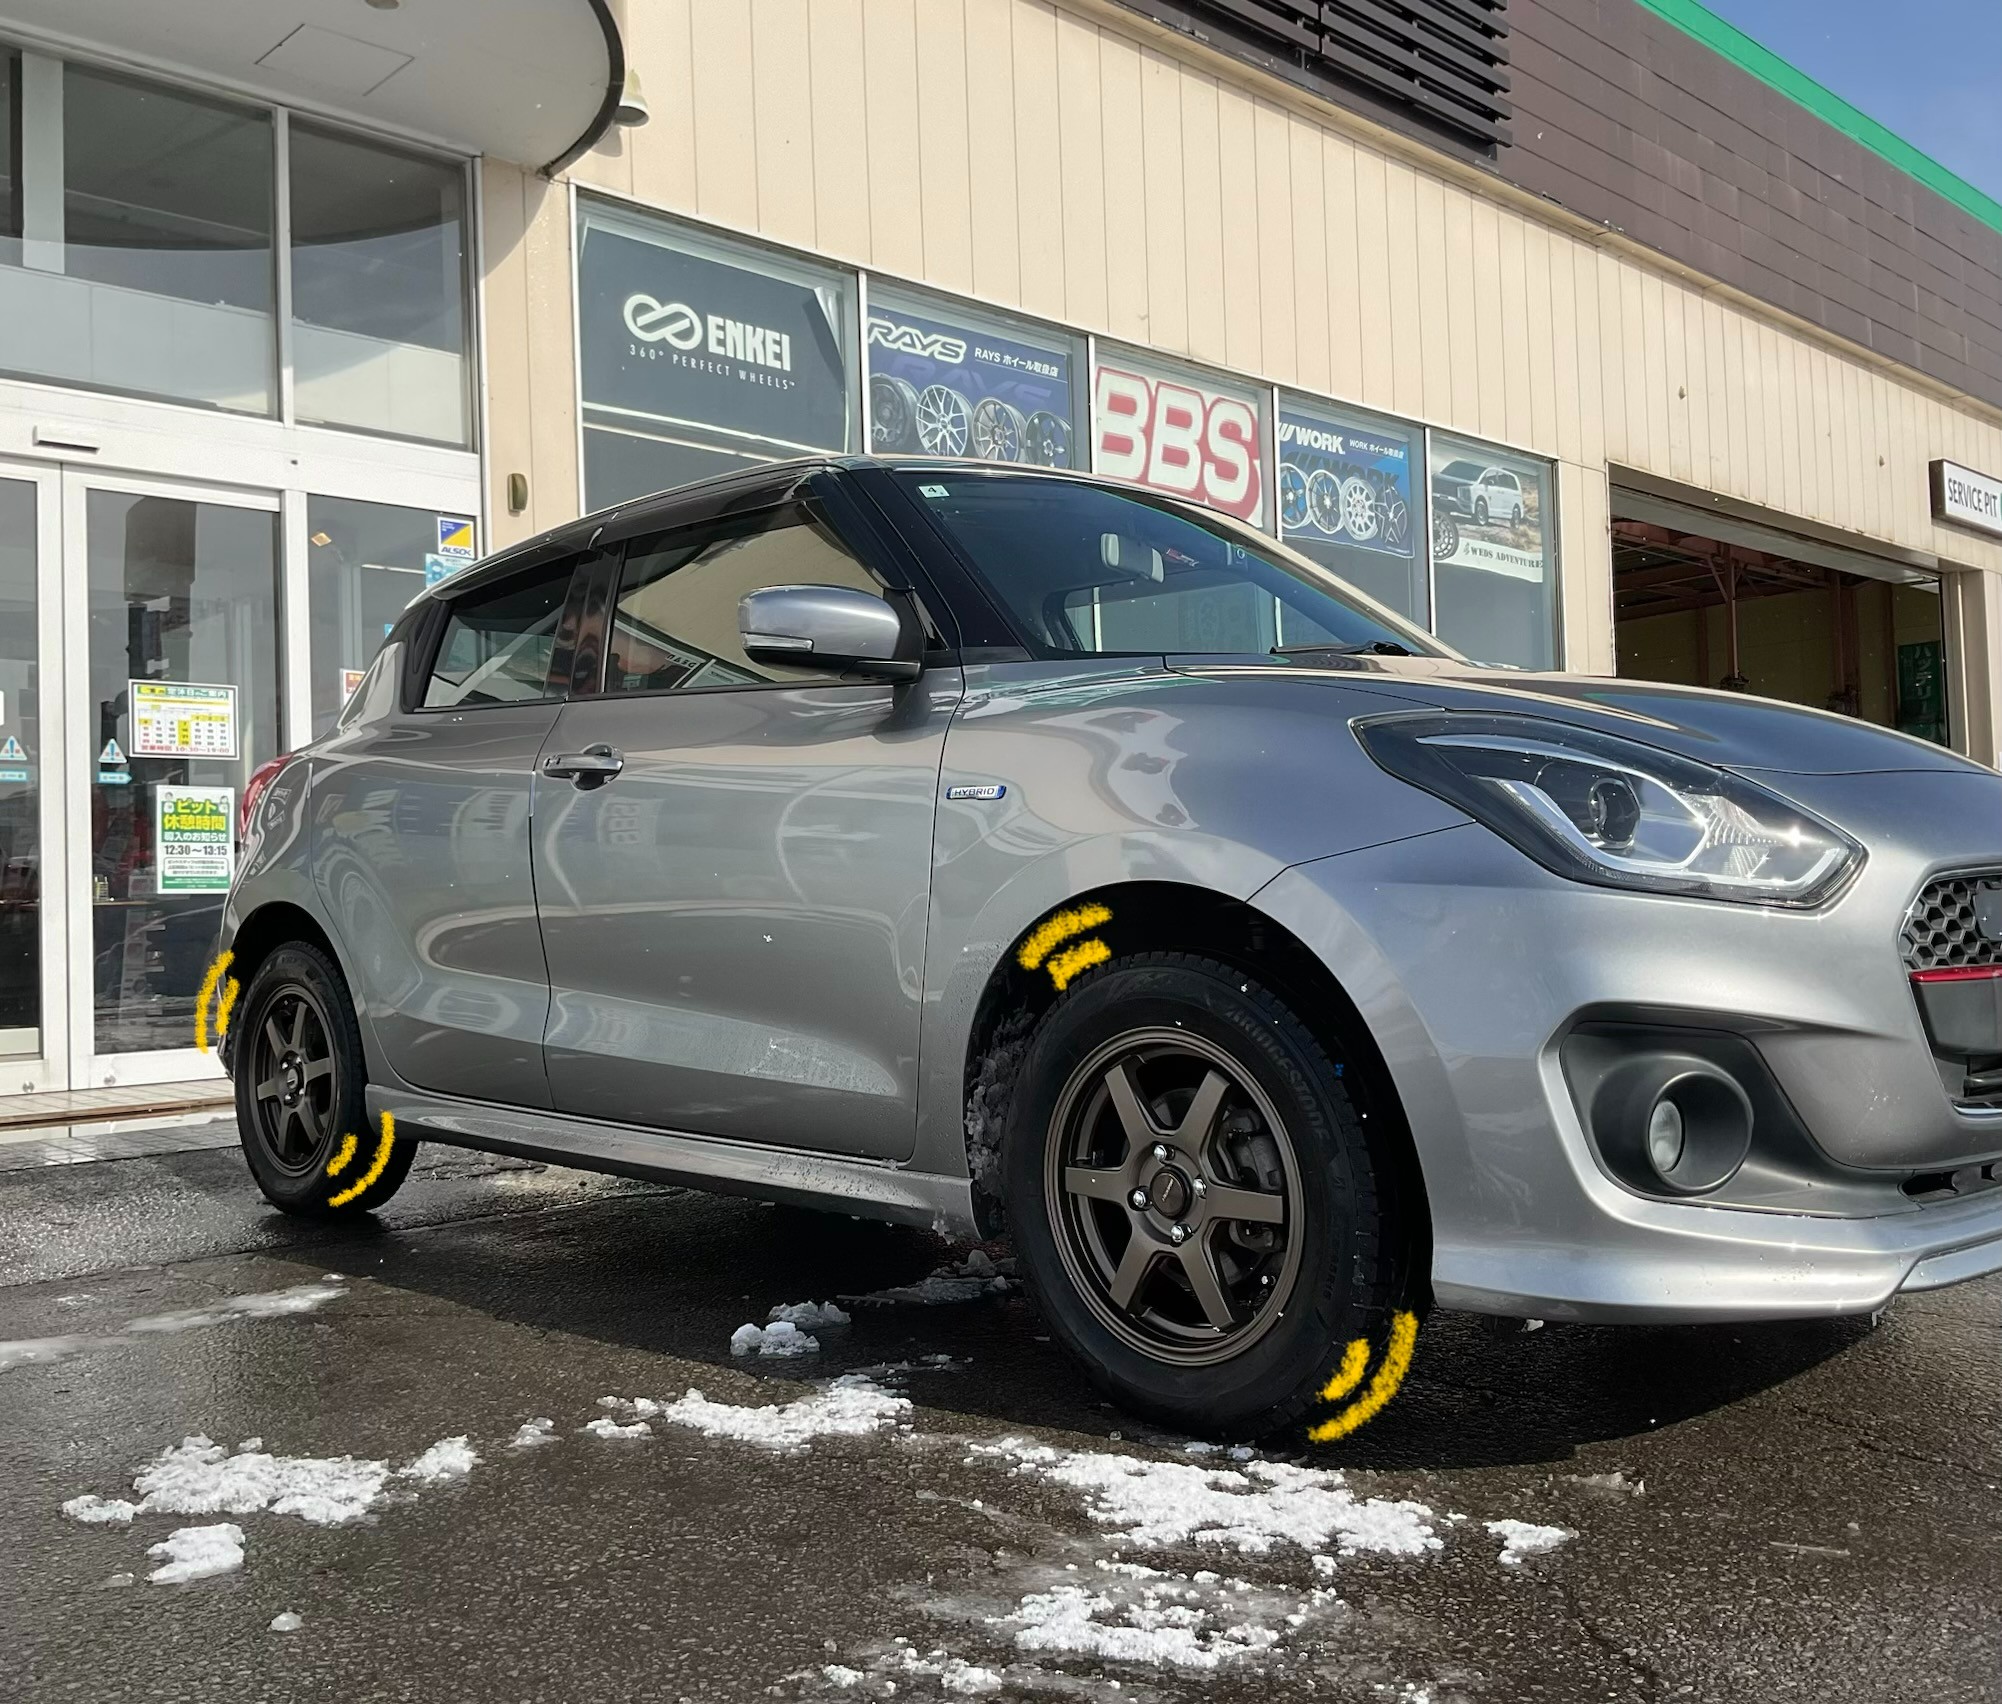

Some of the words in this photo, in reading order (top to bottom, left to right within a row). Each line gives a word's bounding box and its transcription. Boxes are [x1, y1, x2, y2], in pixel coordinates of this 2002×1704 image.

[707, 314, 791, 371] ENKEI
[868, 317, 967, 364] RAYS
[673, 354, 730, 376] PERFECT
[974, 347, 1001, 363] RAYS
[1002, 354, 1060, 378] ホイール取扱店
[1095, 366, 1260, 518] BBS
[1295, 427, 1345, 454] WORK
[1349, 439, 1369, 451] WORK
[1947, 477, 1983, 513] SERVICE
[1984, 491, 1998, 518] PIT
[441, 546, 472, 557] ALSOK
[1471, 547, 1494, 559] WEDS
[1496, 552, 1544, 569] ADVENTURE
[954, 787, 995, 797] HYBRID
[176, 797, 218, 815] ピット
[163, 813, 227, 831] 休憩時間
